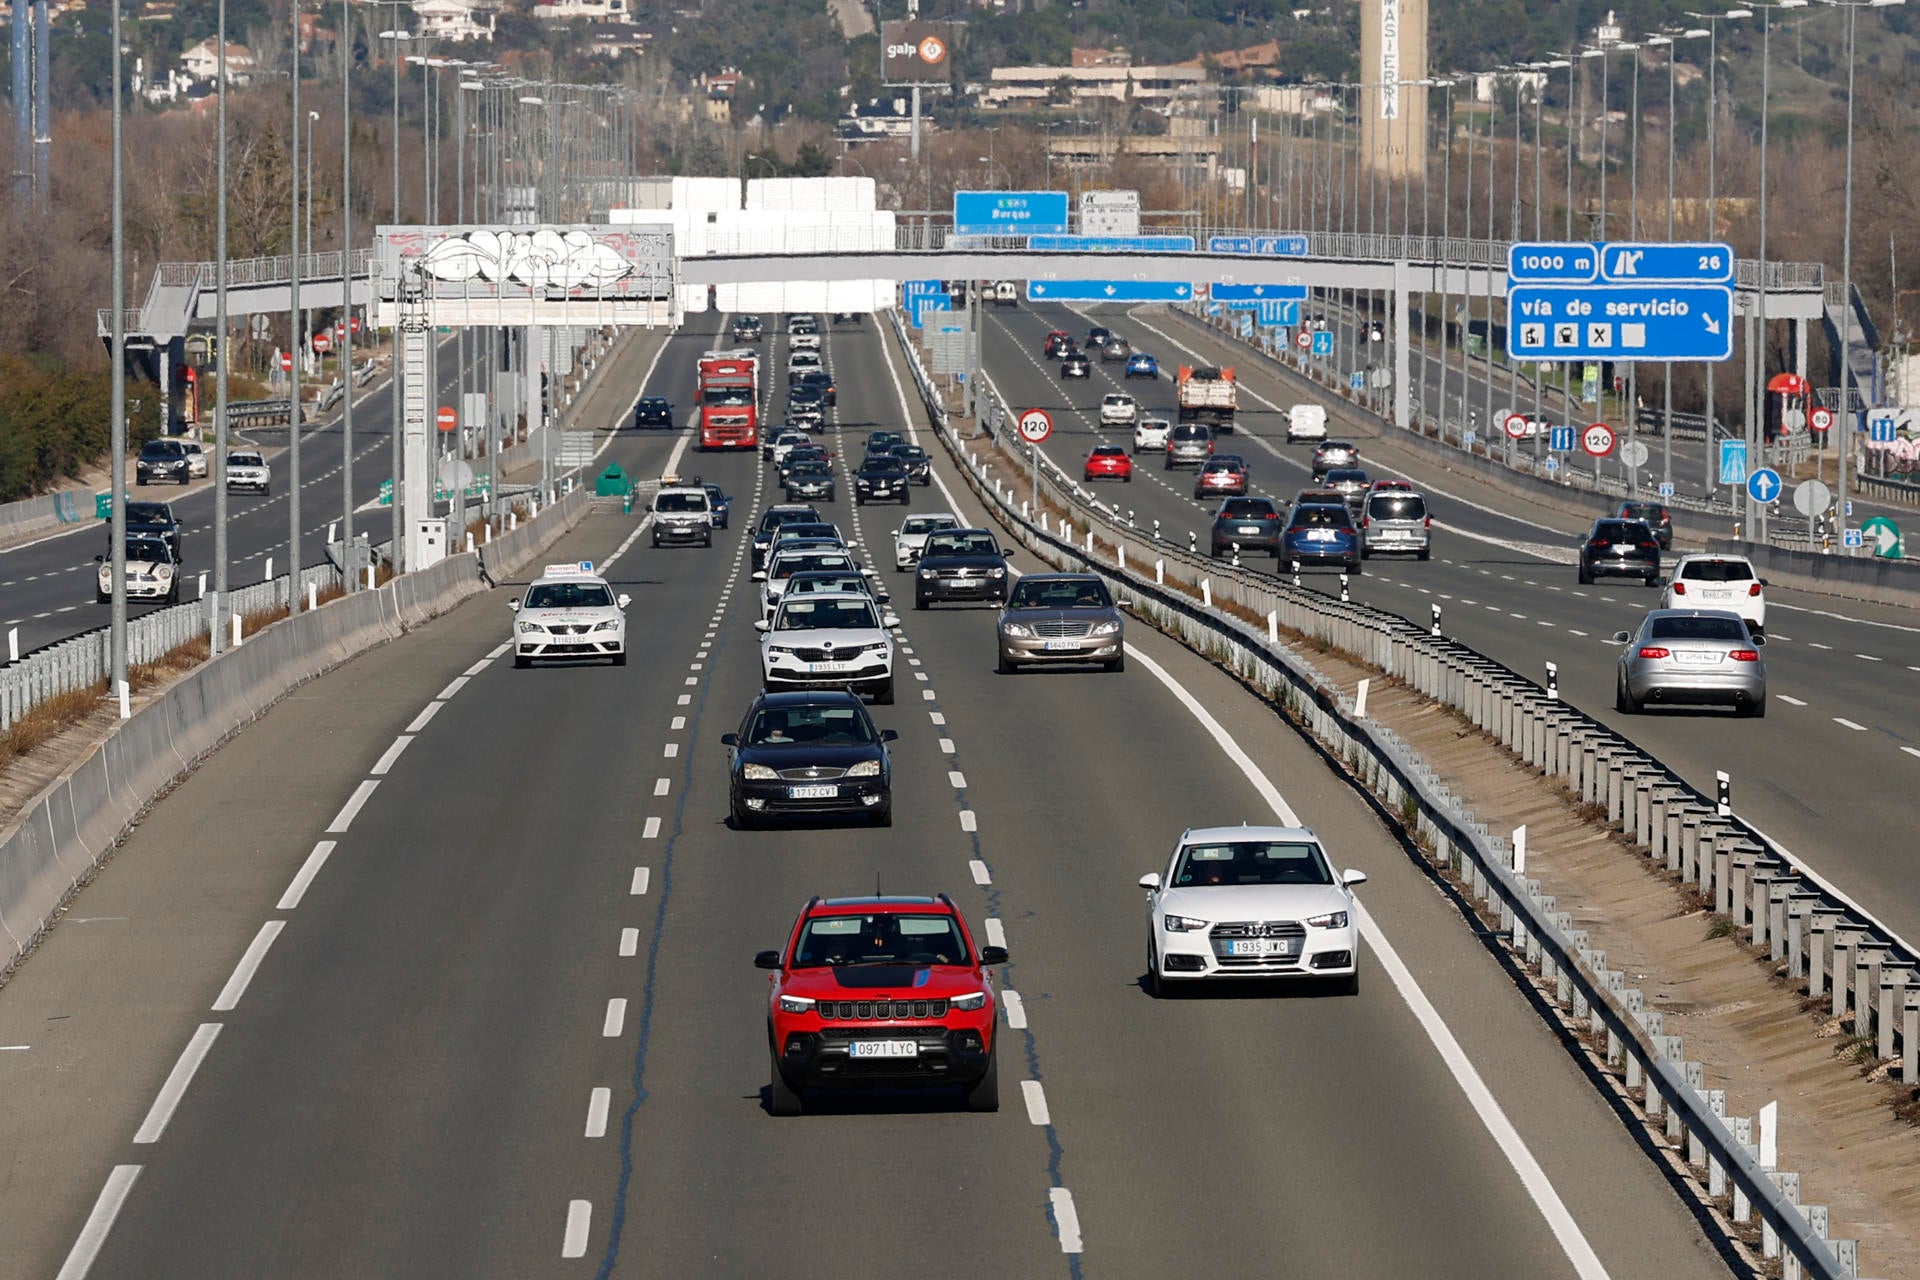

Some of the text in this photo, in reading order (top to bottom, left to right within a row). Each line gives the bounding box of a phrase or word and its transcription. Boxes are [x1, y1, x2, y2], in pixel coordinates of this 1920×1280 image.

[887, 42, 917, 58] galp
[1521, 256, 1590, 270] 1000 m
[1698, 256, 1721, 270] 26
[1521, 298, 1689, 316] vía de servicio
[1814, 415, 1828, 425] 80
[1024, 421, 1047, 432] 120
[1587, 436, 1610, 445] 120
[797, 787, 835, 797] 1712 CVT
[1237, 941, 1285, 952] 1935 JWC
[858, 1043, 913, 1055] 0971 LYC
